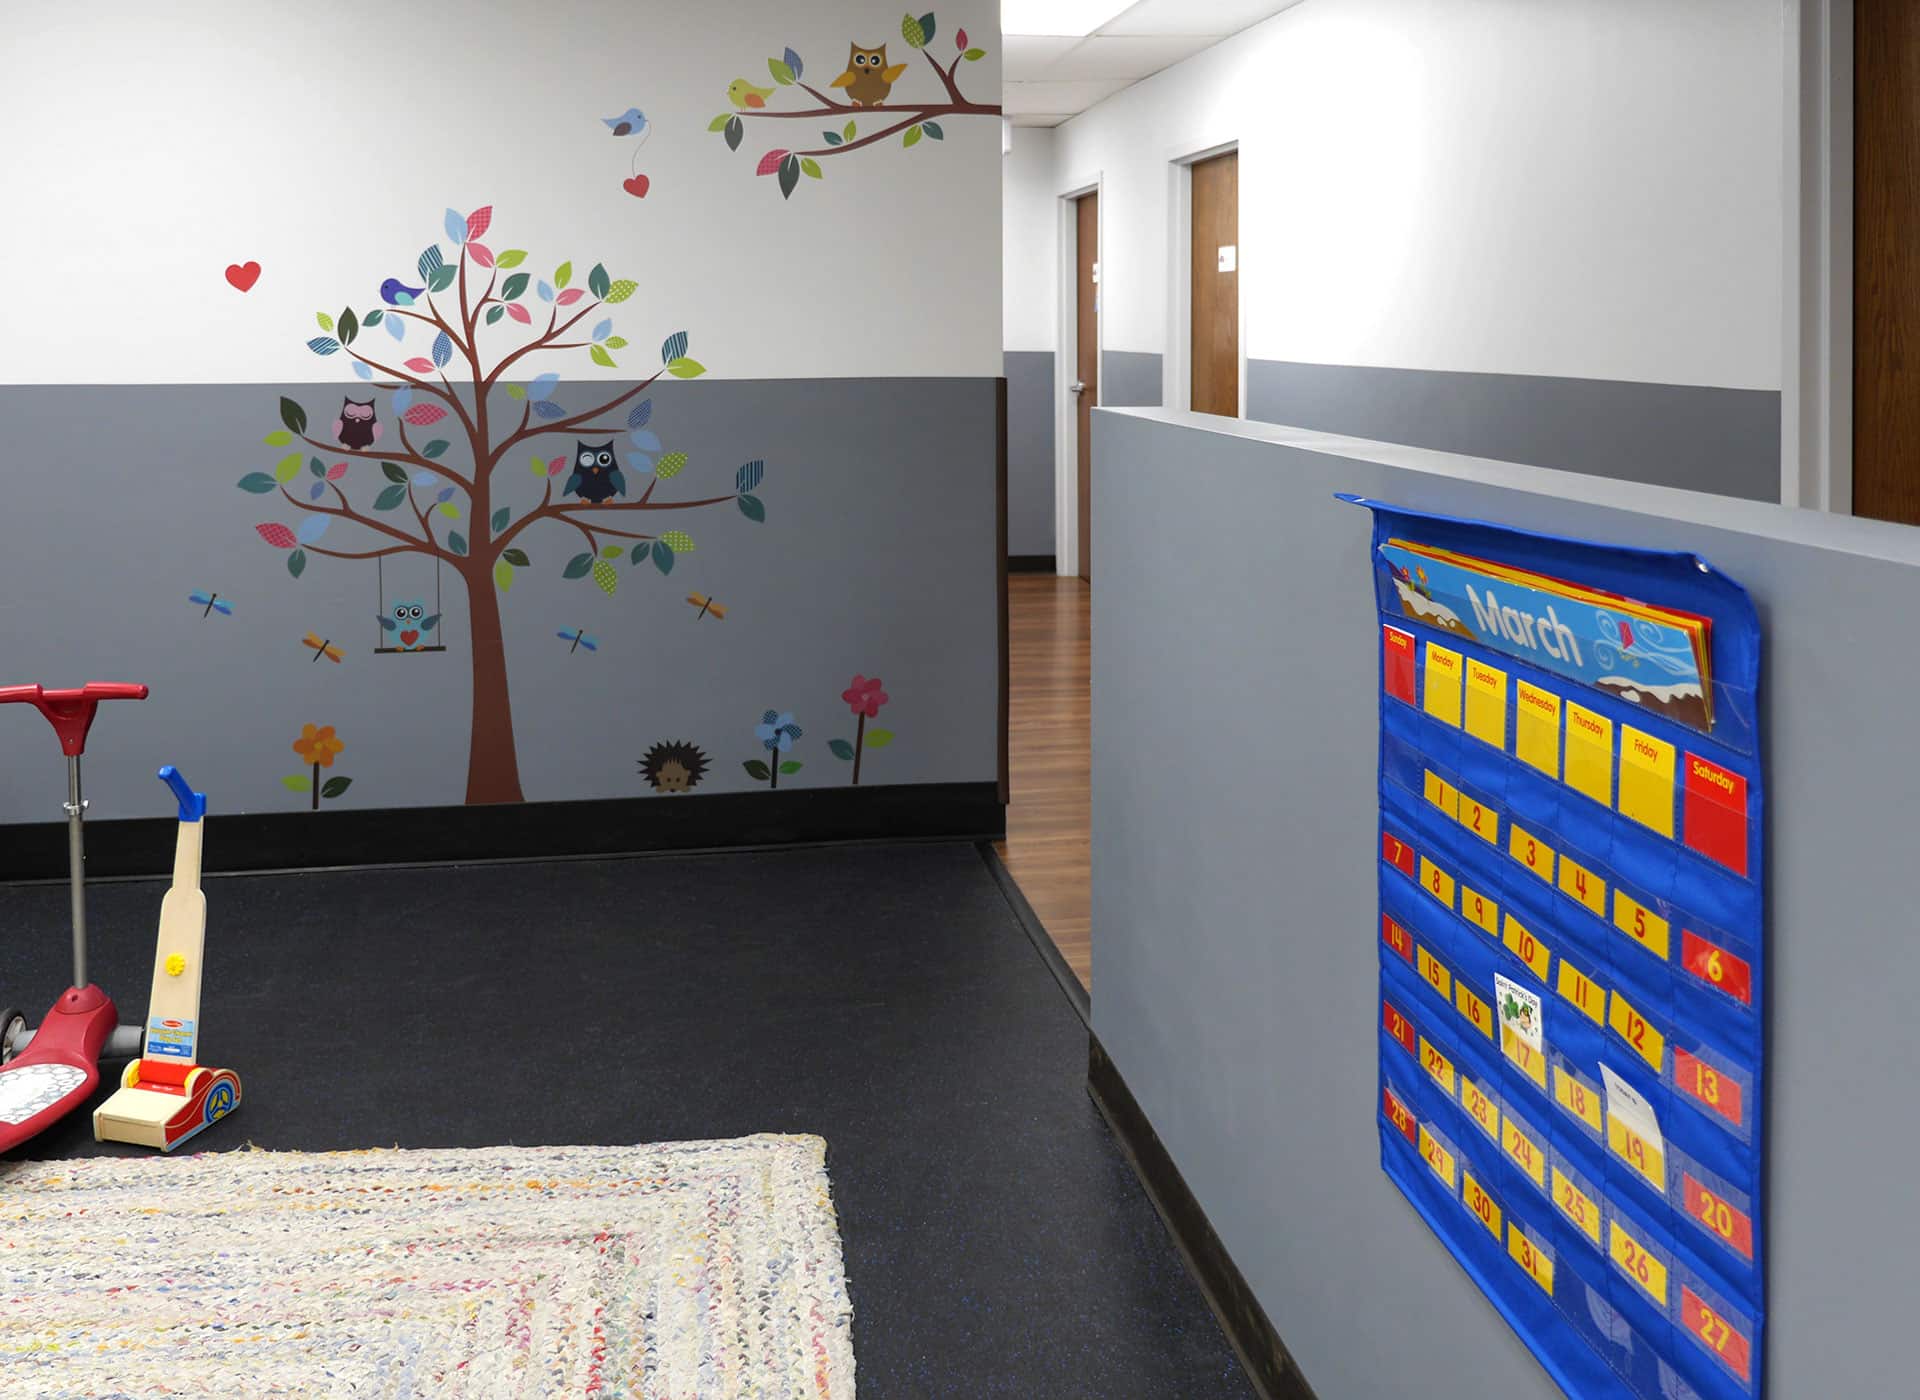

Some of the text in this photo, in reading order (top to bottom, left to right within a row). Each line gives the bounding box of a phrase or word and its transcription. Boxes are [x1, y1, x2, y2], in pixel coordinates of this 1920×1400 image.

[1389, 632, 1735, 795] Sunday Monday Tuesday Wednesday Thursday Friday Saturday
[1466, 583, 1583, 667] March
[1394, 841, 1718, 1104] 7 8 9 10 11 12 13
[1439, 783, 1723, 982] 1 2 3 4 5 6
[1391, 922, 1404, 952] 14
[1427, 957, 1440, 986] 15
[1467, 993, 1480, 1024] 16
[1516, 1039, 1530, 1068] 17
[1570, 1083, 1586, 1113] 18
[1625, 1132, 1645, 1170] 19
[1700, 1191, 1732, 1239] 20
[1392, 1013, 1731, 1352] 21 22 23 24 25 26 27
[1392, 1101, 1538, 1276] 28 29 30 31
